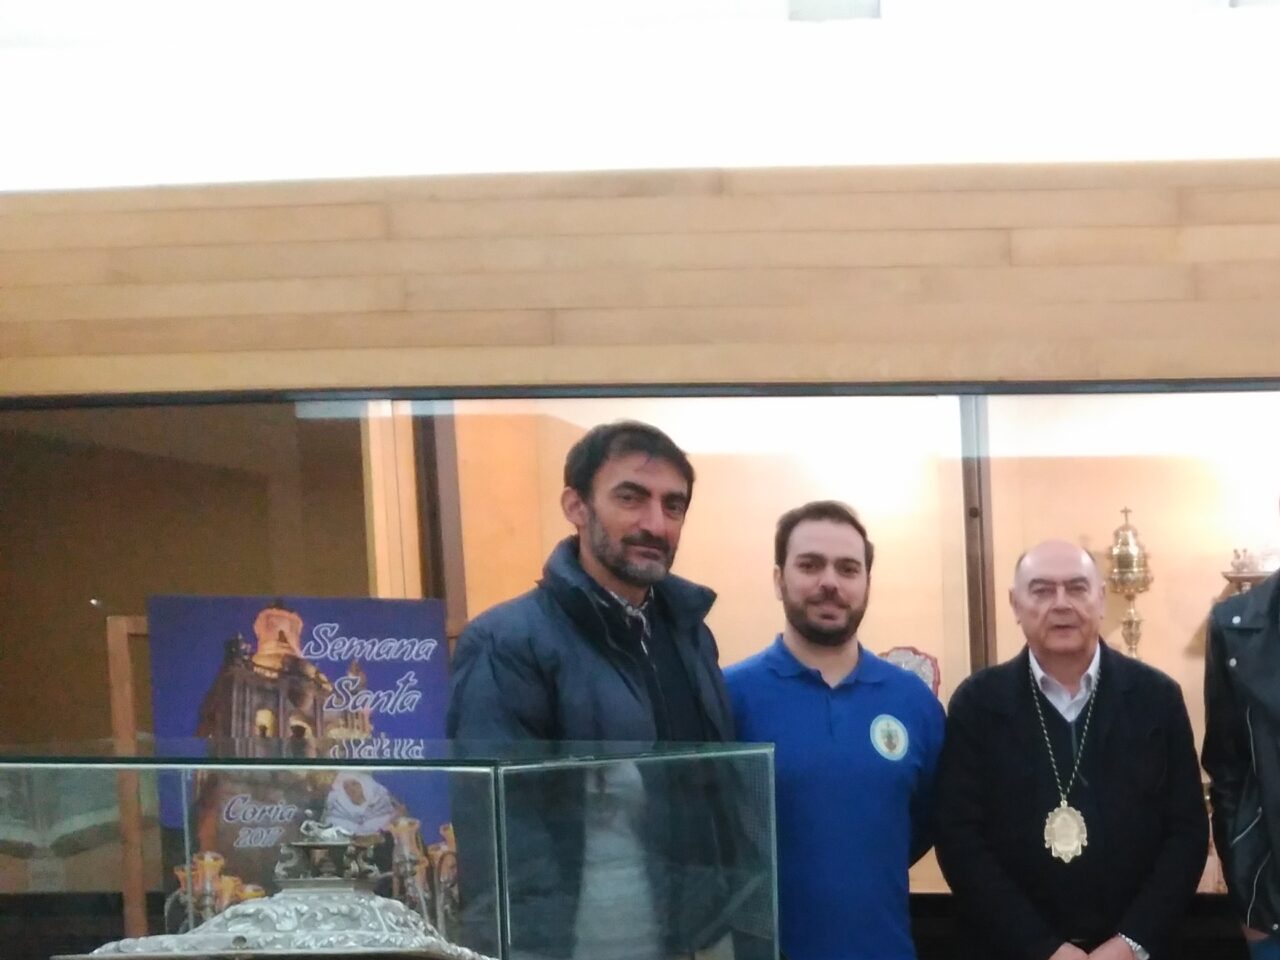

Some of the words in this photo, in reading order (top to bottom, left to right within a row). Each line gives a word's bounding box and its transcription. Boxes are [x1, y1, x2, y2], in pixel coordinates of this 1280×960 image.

[301, 623, 438, 661] Semana
[323, 671, 422, 715] Santa
[223, 793, 298, 823] Coria
